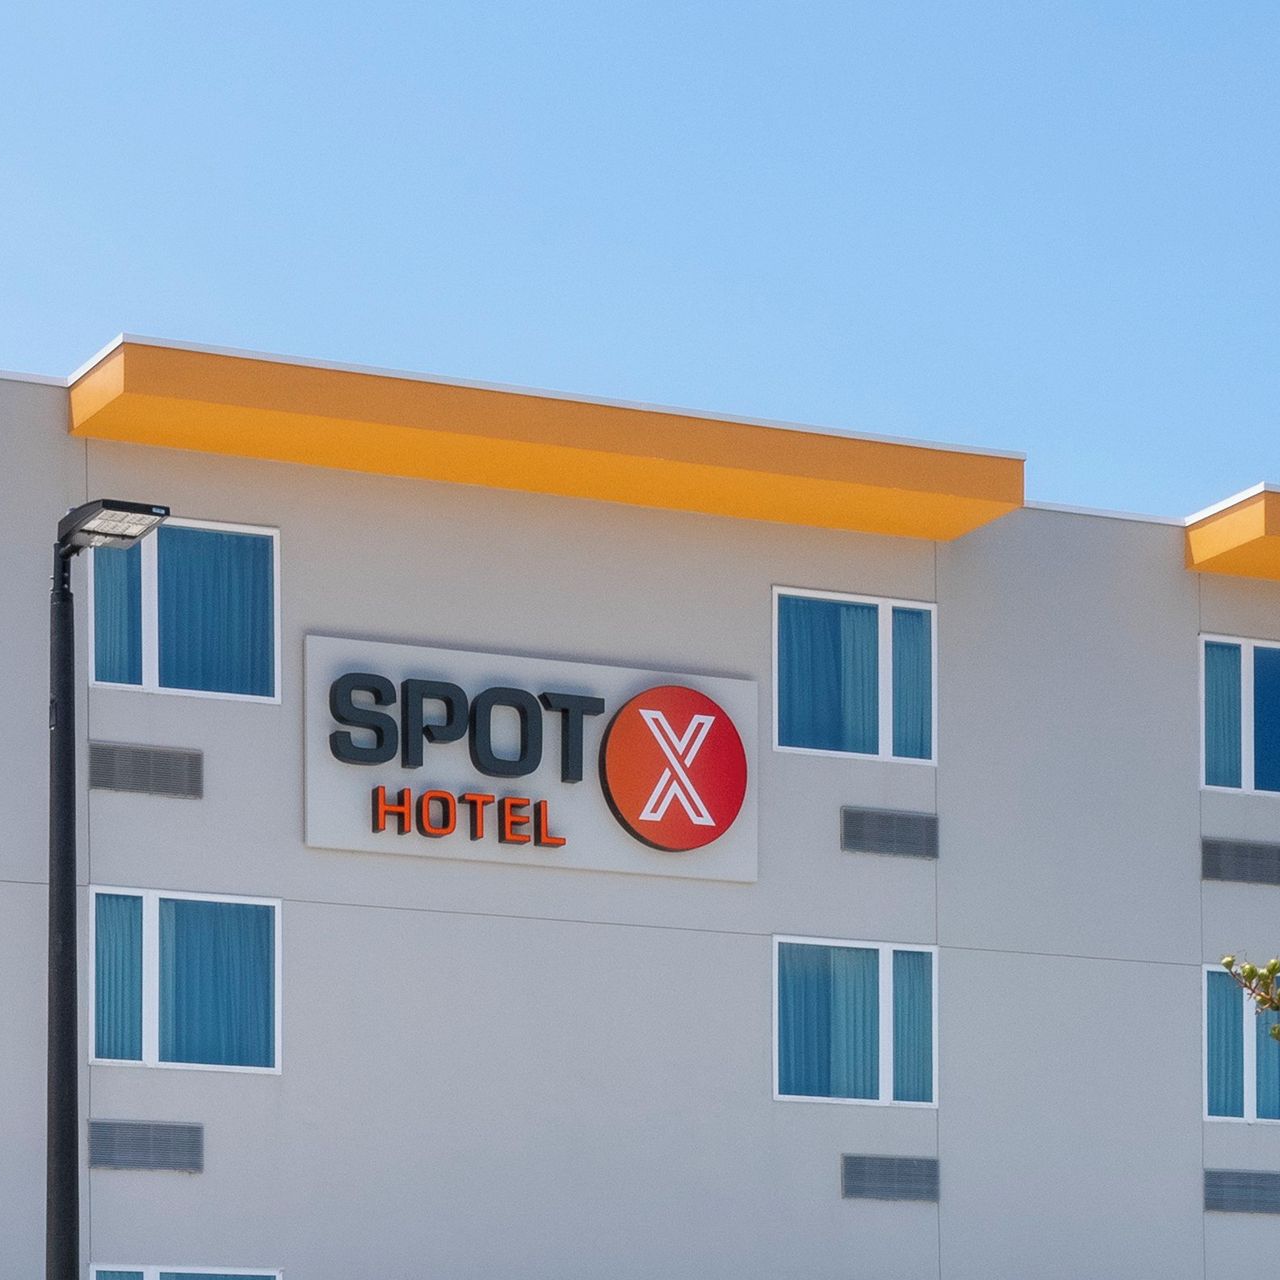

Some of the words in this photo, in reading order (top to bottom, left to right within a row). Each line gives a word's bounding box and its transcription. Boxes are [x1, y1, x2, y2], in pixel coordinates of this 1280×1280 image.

[329, 672, 605, 783] SPOT
[638, 708, 716, 827] X
[372, 785, 566, 847] HOTEL
